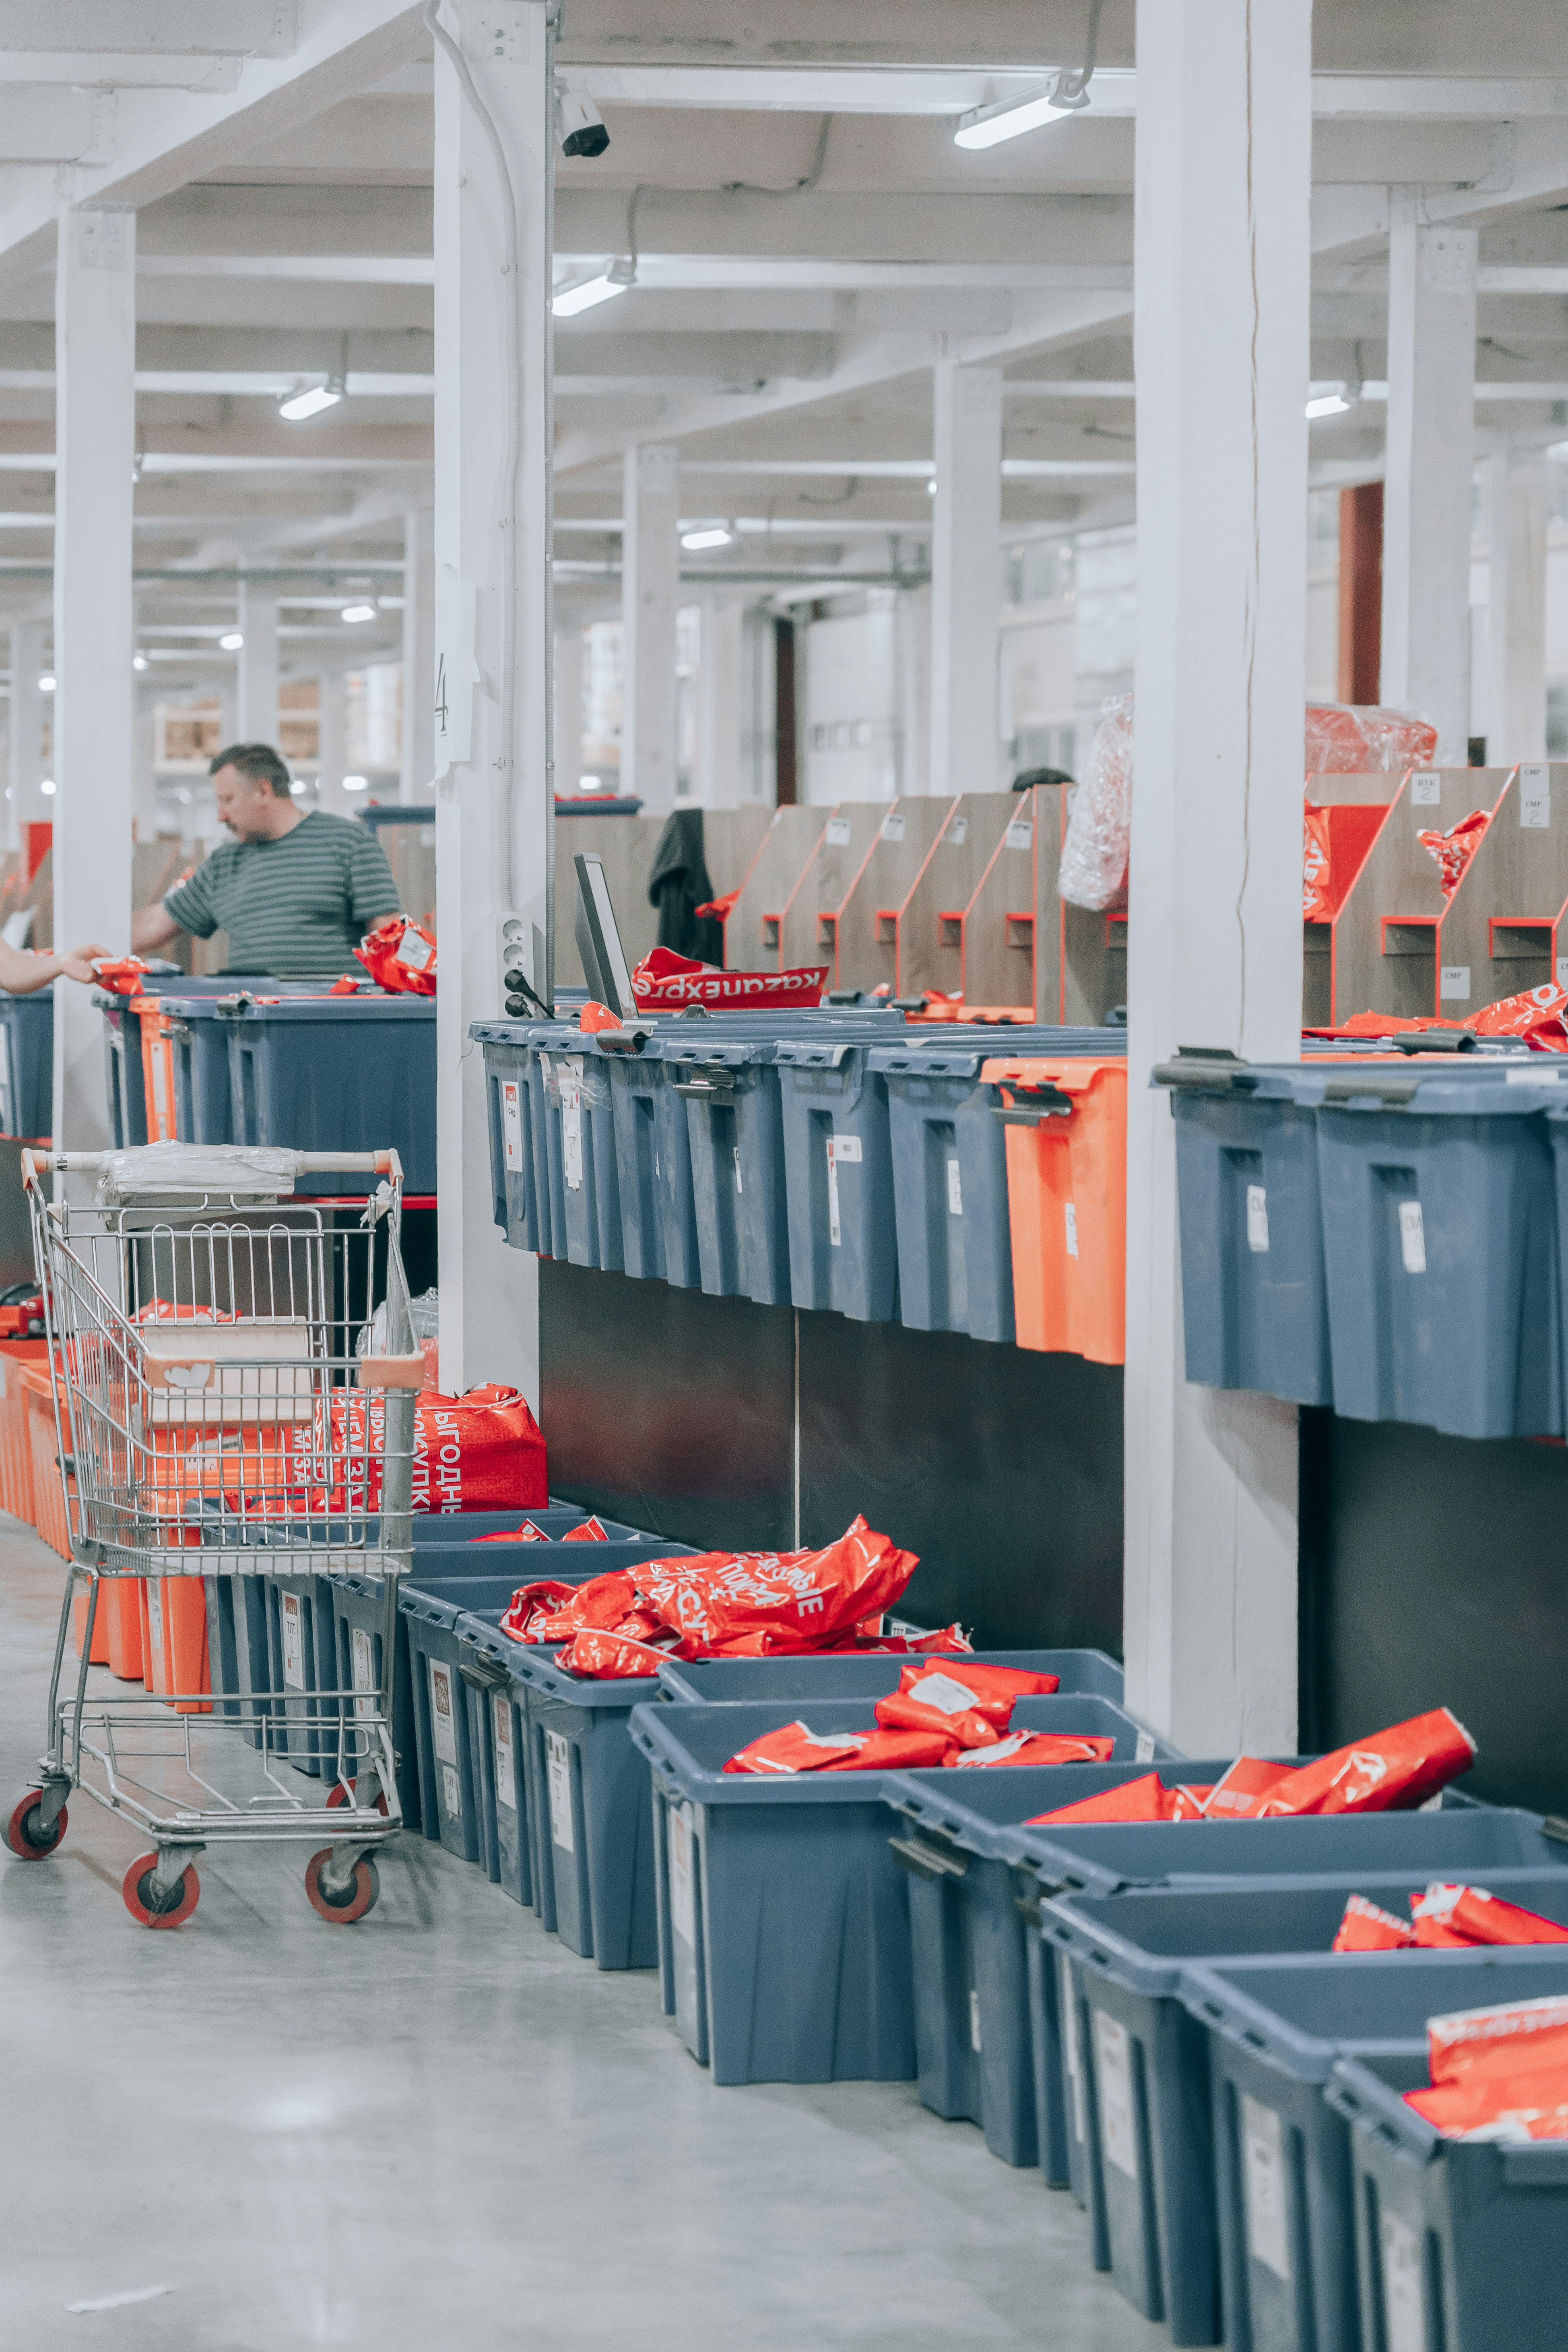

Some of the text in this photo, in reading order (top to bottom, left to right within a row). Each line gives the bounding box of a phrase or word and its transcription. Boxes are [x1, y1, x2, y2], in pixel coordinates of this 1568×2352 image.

[1420, 787, 1432, 801] 2
[1529, 810, 1541, 825] 2
[633, 971, 820, 1000] KazanExpre
[434, 1411, 462, 1514] ЫГОДН
